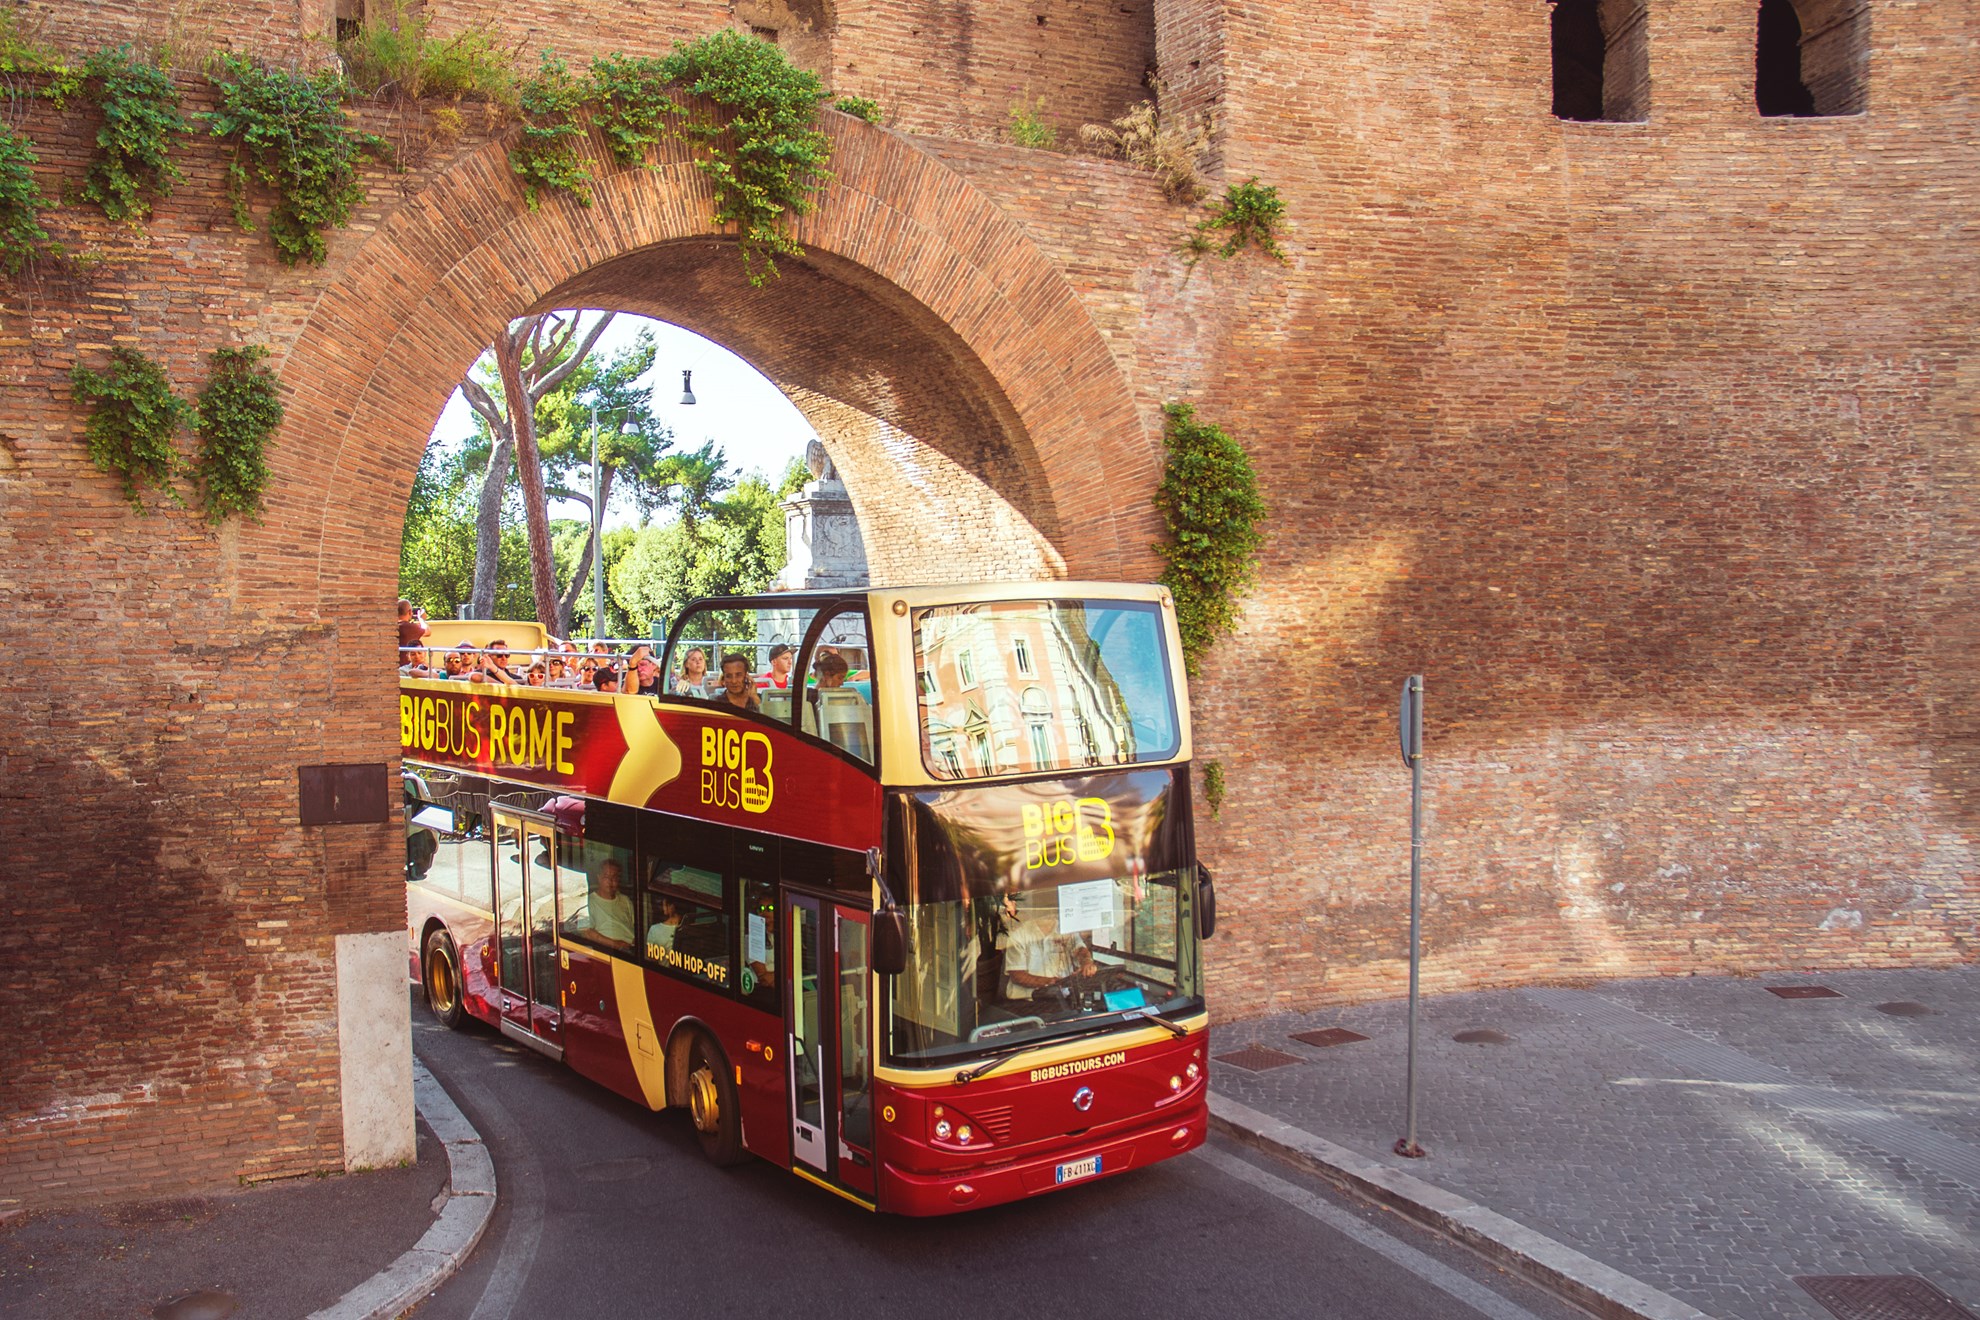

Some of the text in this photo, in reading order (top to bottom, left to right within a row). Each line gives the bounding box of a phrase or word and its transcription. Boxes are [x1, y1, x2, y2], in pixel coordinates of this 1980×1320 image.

[489, 704, 574, 775] ROME
[702, 726, 740, 770] BIG
[701, 768, 740, 810] BUS
[1021, 800, 1074, 838] BIG
[1025, 835, 1076, 870] BUS
[647, 942, 727, 983] HOP-ON HOP-OFF
[1030, 1051, 1126, 1083] BIGBUSTOURS.COM
